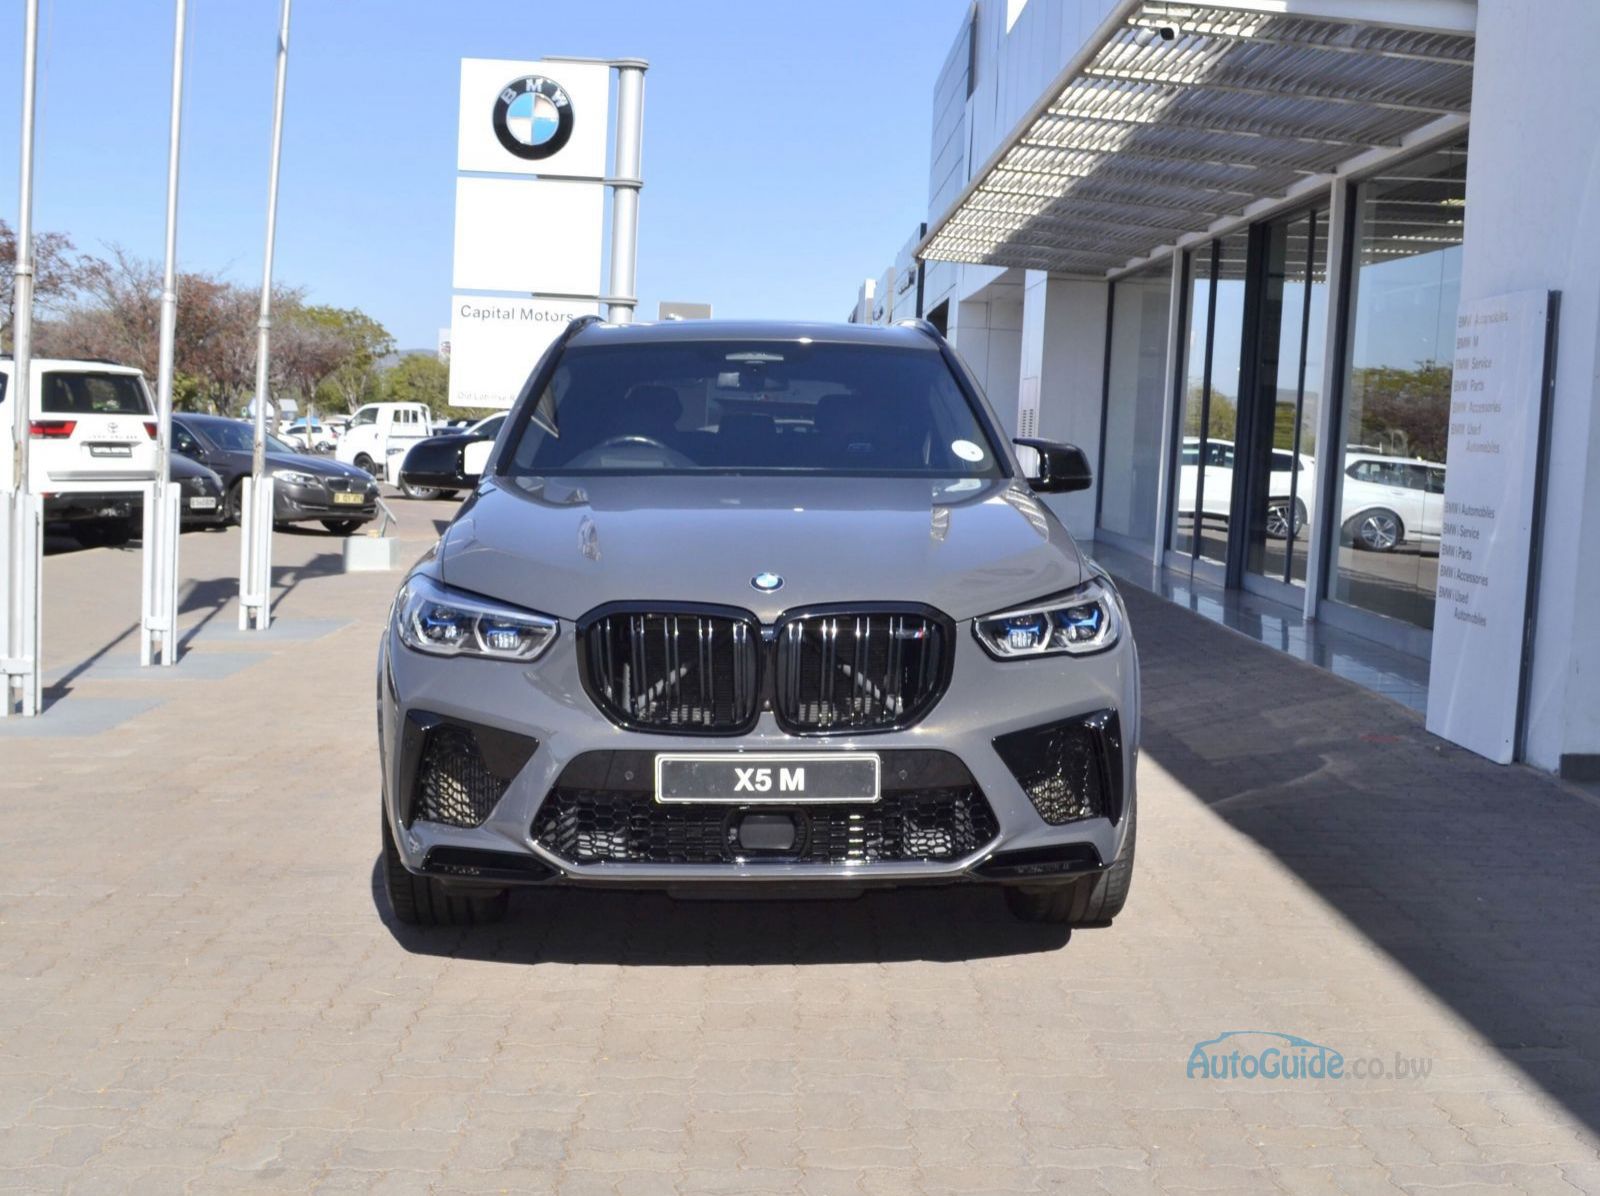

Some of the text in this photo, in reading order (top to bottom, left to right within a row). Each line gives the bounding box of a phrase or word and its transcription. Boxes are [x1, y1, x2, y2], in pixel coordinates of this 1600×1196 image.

[500, 78, 569, 107] BMW
[460, 304, 574, 323] Capital Motors
[1459, 524, 1480, 540] Service
[1458, 546, 1472, 560] Parts
[1456, 568, 1488, 587] Accessories
[733, 768, 805, 791] X5 M
